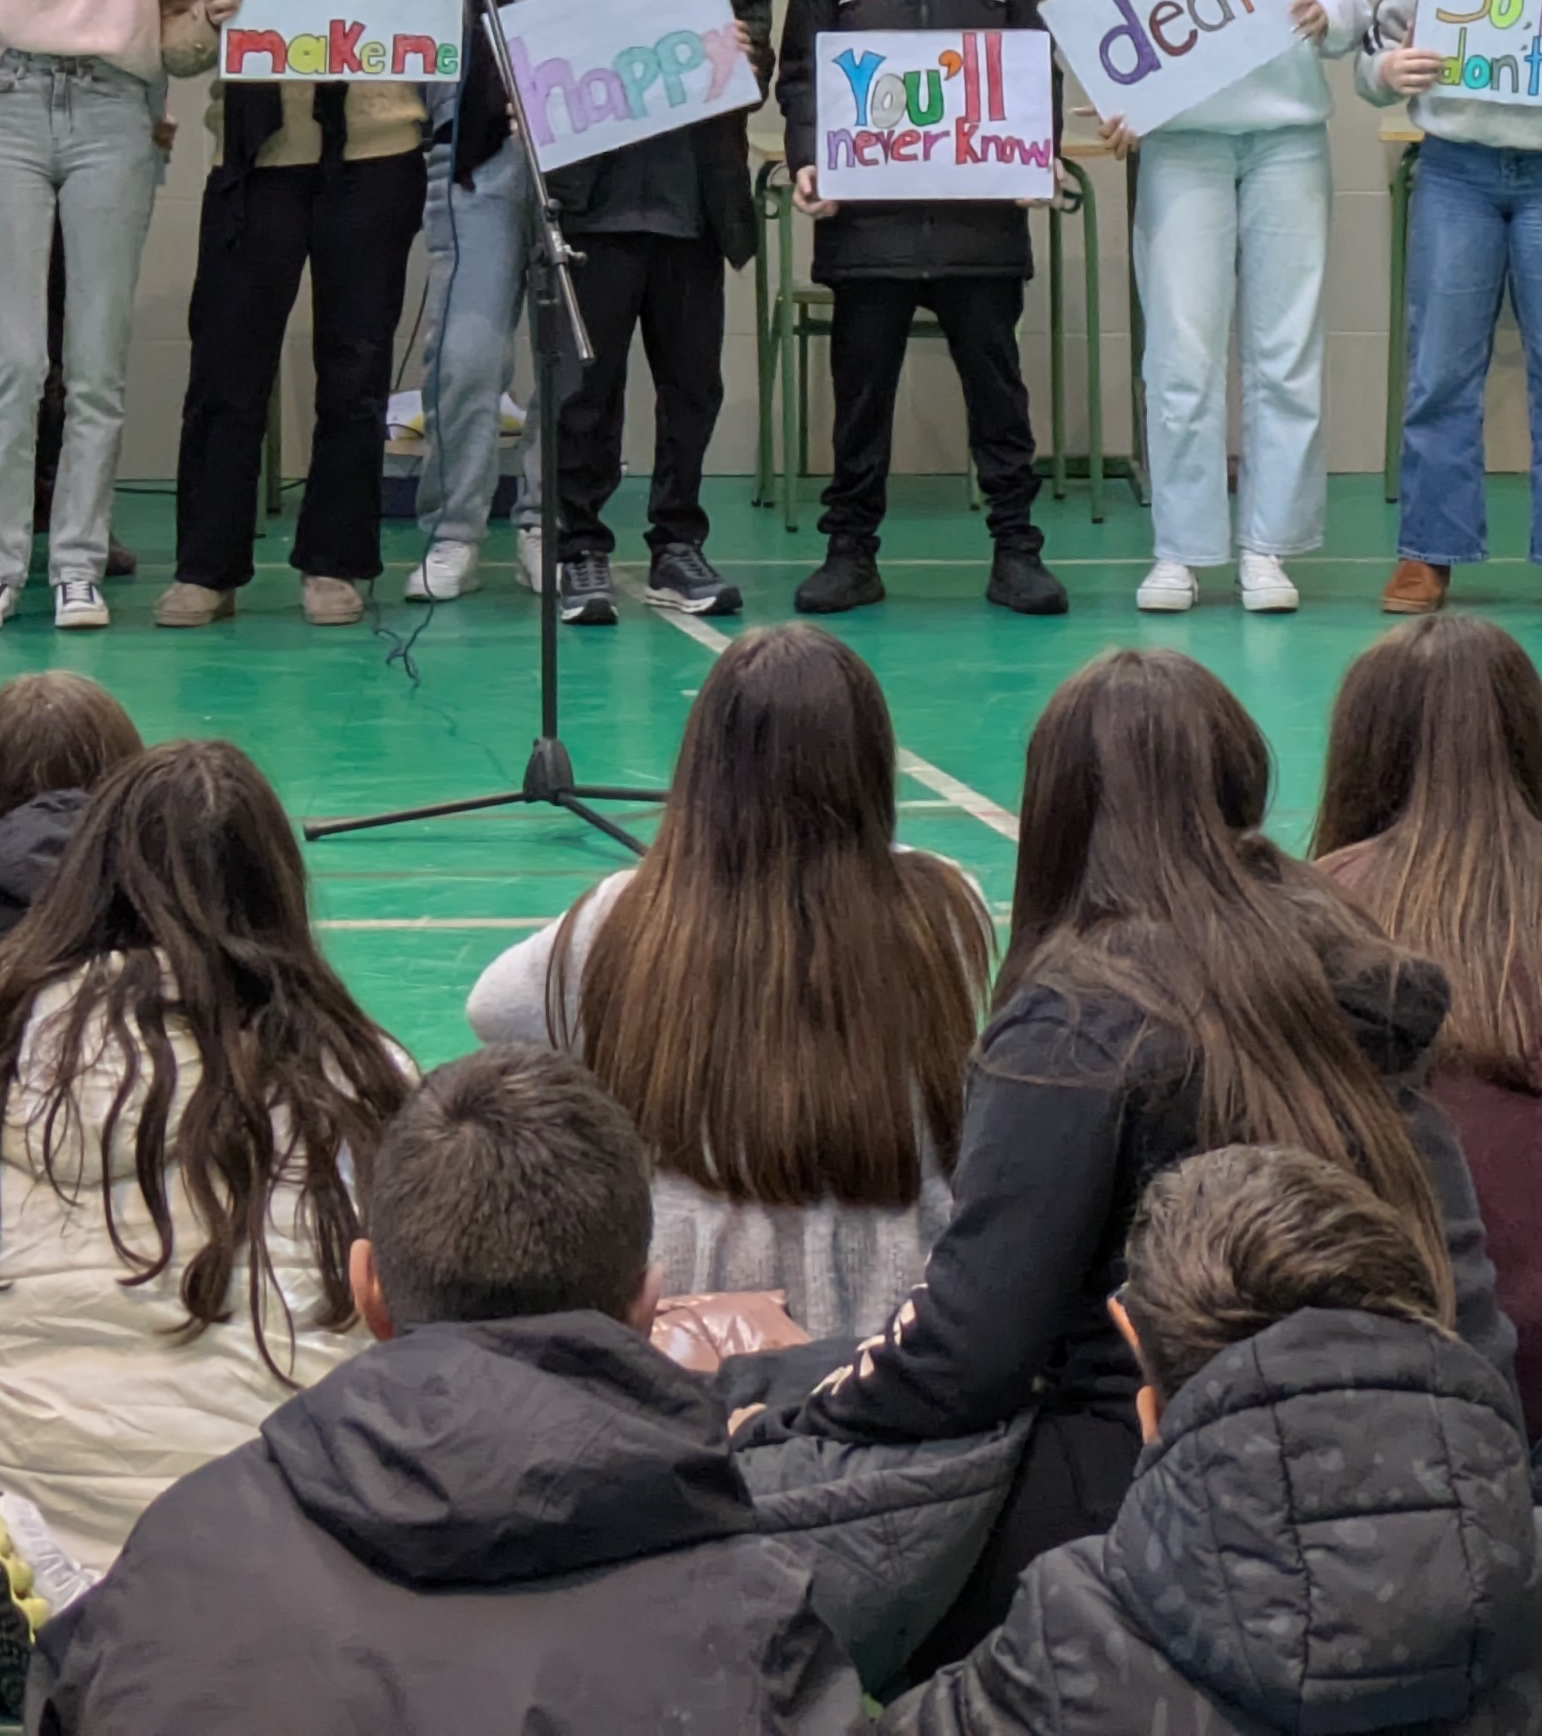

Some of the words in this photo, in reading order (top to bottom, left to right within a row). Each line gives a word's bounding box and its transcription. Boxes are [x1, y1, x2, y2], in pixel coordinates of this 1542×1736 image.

[509, 23, 739, 146] happy
[832, 32, 1006, 128] You'll
[827, 128, 950, 170] never
